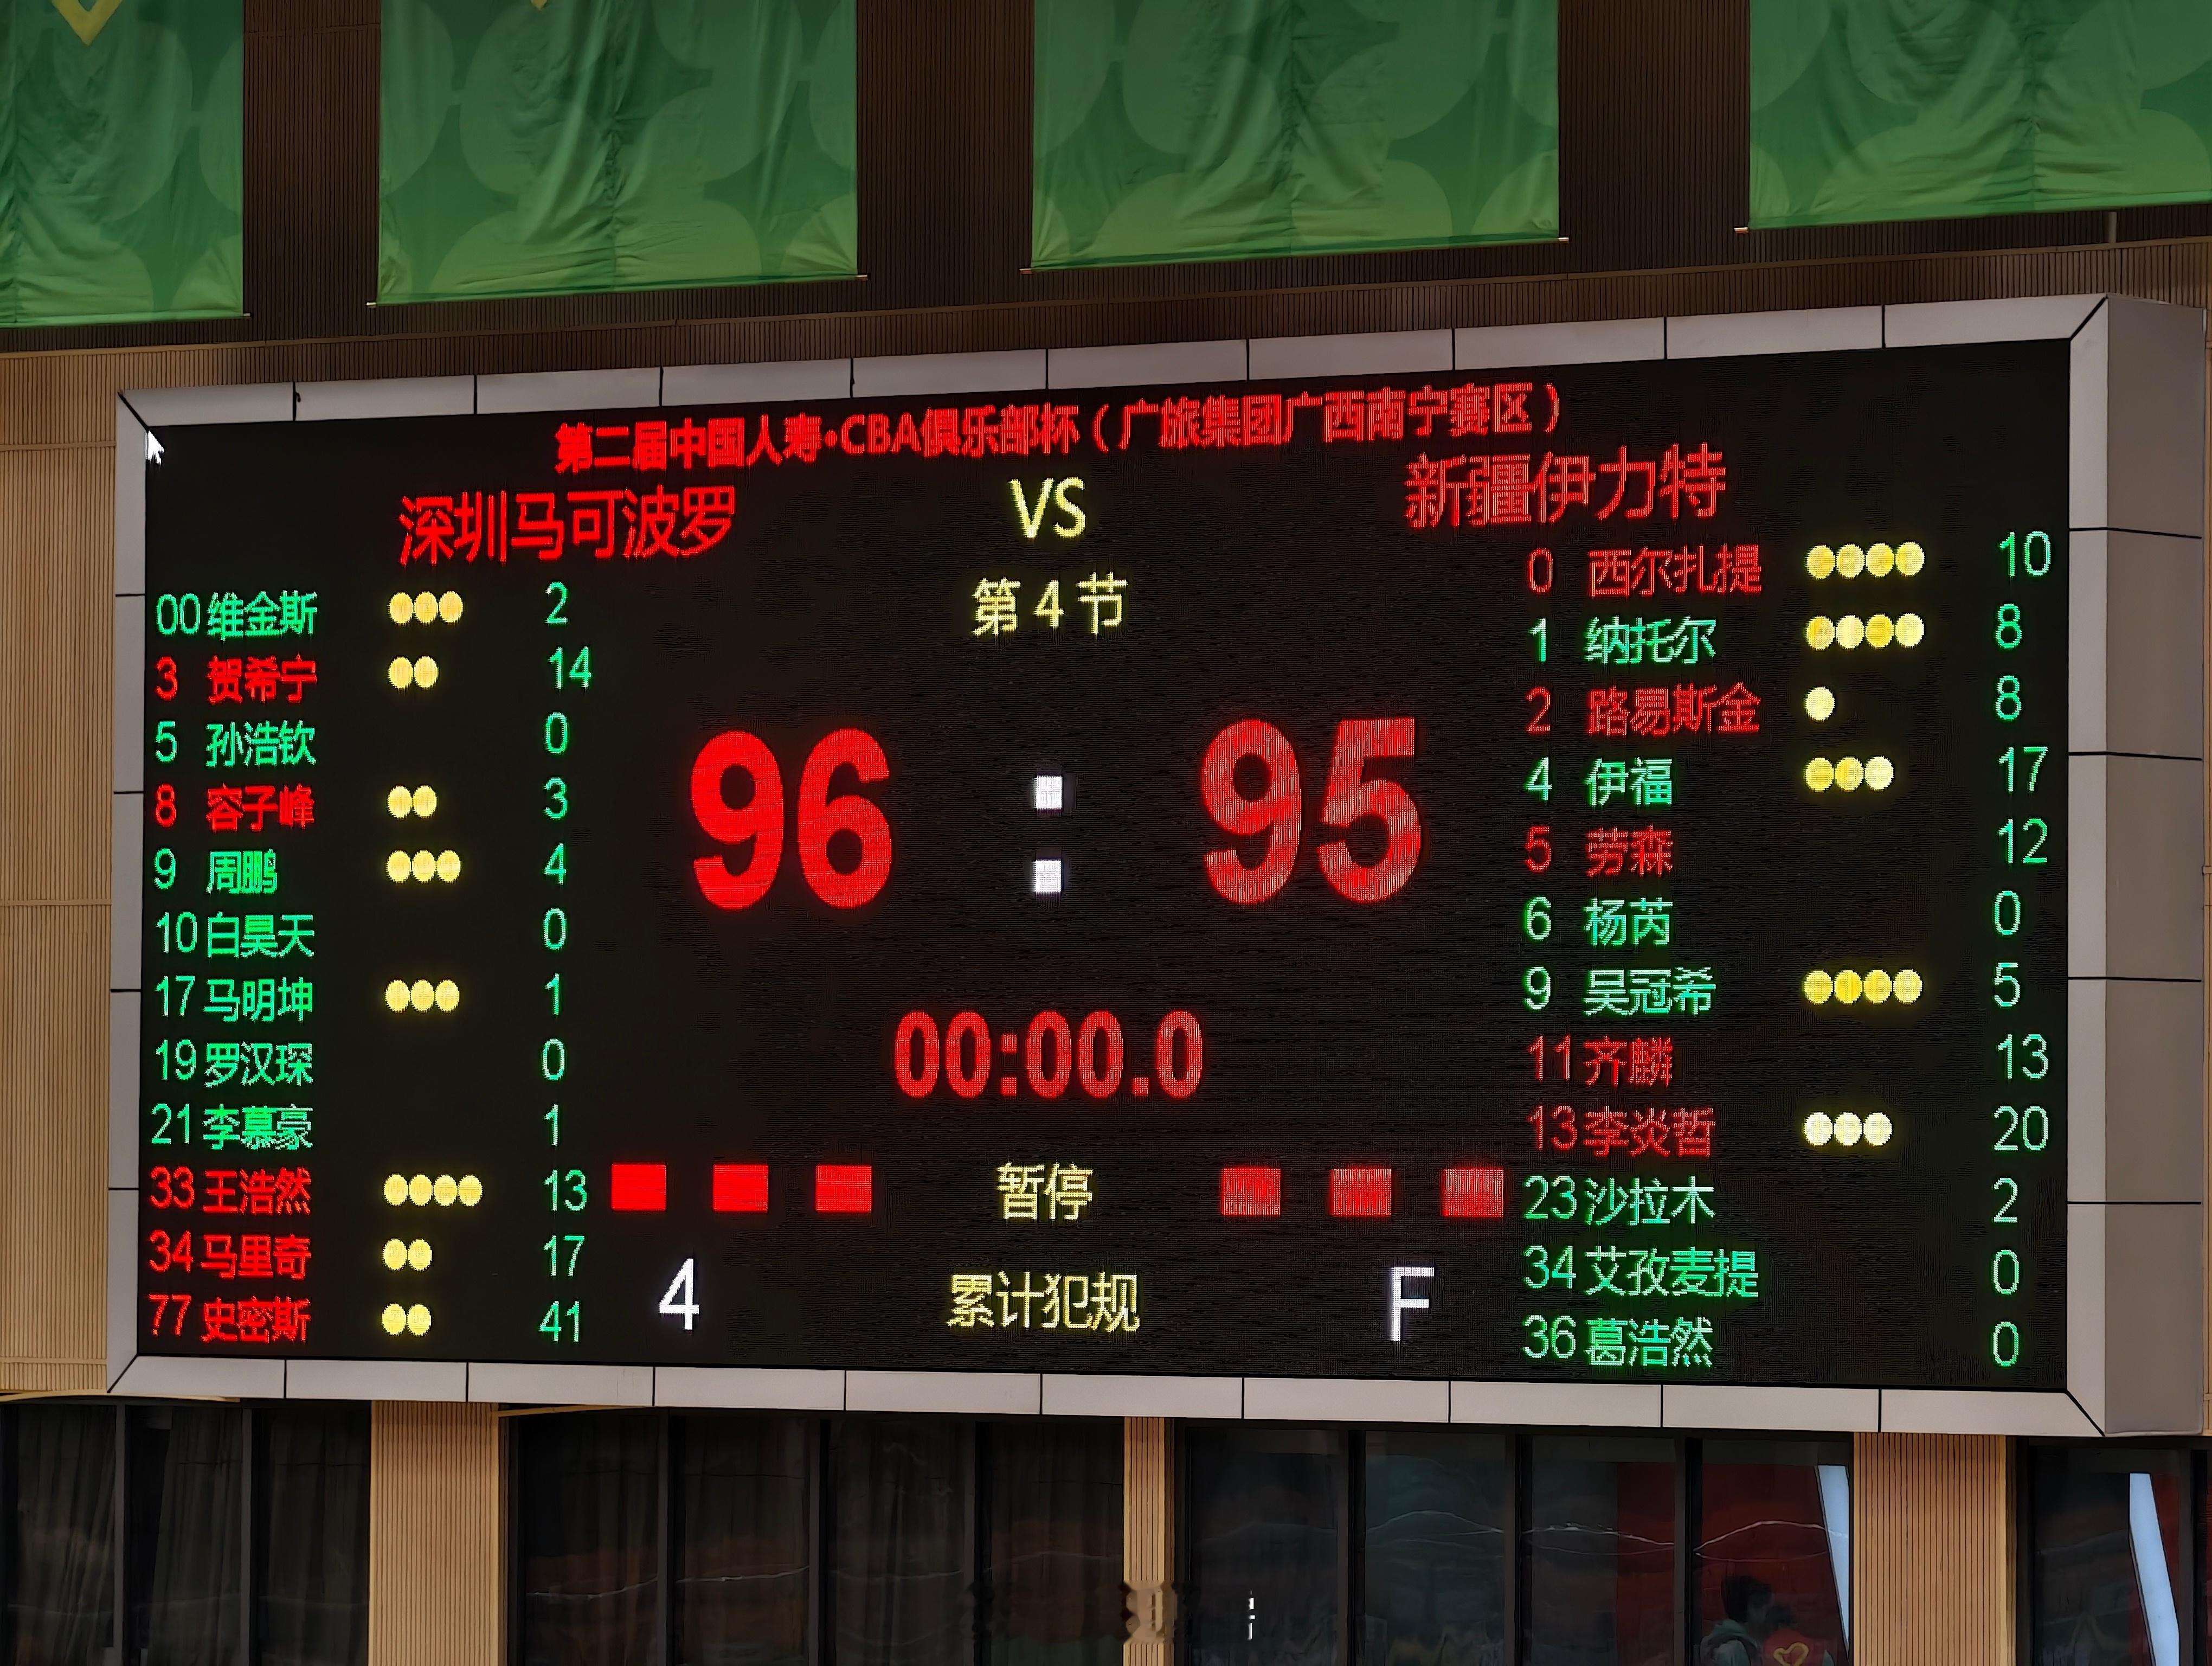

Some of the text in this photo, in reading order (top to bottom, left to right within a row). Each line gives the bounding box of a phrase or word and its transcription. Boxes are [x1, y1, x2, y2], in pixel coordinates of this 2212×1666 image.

[1009, 477, 1085, 539] VS
[1404, 443, 1726, 529] 新疆伊力特
[399, 484, 735, 566] 深圳马可波罗
[1528, 531, 2050, 597] 0 西尔扎提 10
[157, 582, 568, 641] 00 维金斯 2
[1530, 604, 2022, 664] 1 纳托尔 8
[156, 646, 591, 704] 3 贺希宁 14
[1526, 675, 2022, 736] 2 路易斯金 8
[156, 712, 568, 767] 5 孙浩钦 0
[1526, 746, 2048, 805] 4 伊福 17
[155, 778, 568, 832] 8 容子峰 3
[690, 728, 892, 911] 96
[1200, 717, 1421, 905] 95
[154, 843, 566, 894] 9 周鹏 4
[1525, 818, 2047, 877] 5 劳森 12
[157, 908, 567, 958] 10 白昊天 0
[1525, 890, 2021, 946] 6 杨芮 0
[156, 973, 559, 1022] 17 马明坤 1
[1524, 963, 2020, 1016] 9 吴冠希 5
[156, 1039, 564, 1088] 19 罗汉琛 0
[894, 1010, 1203, 1098] 00:00.0
[1528, 1034, 2048, 1086] 11 齐麟 13
[152, 1104, 558, 1150] 21 李慕豪 1
[1528, 1106, 2048, 1157] 13 李炎哲 20
[150, 1167, 587, 1215] 33 王浩然 13
[997, 1162, 1093, 1220] 暂停
[1524, 1176, 2017, 1226] 23 沙拉木 2
[149, 1230, 584, 1280] 34 马里奇 17
[1524, 1245, 2019, 1297] 34 艾孜麦提 0
[148, 1294, 579, 1343] 77 史密斯 41
[659, 1259, 1434, 1343] 4 累计犯规 F
[1523, 1315, 2018, 1367] 36 葛浩然 0
